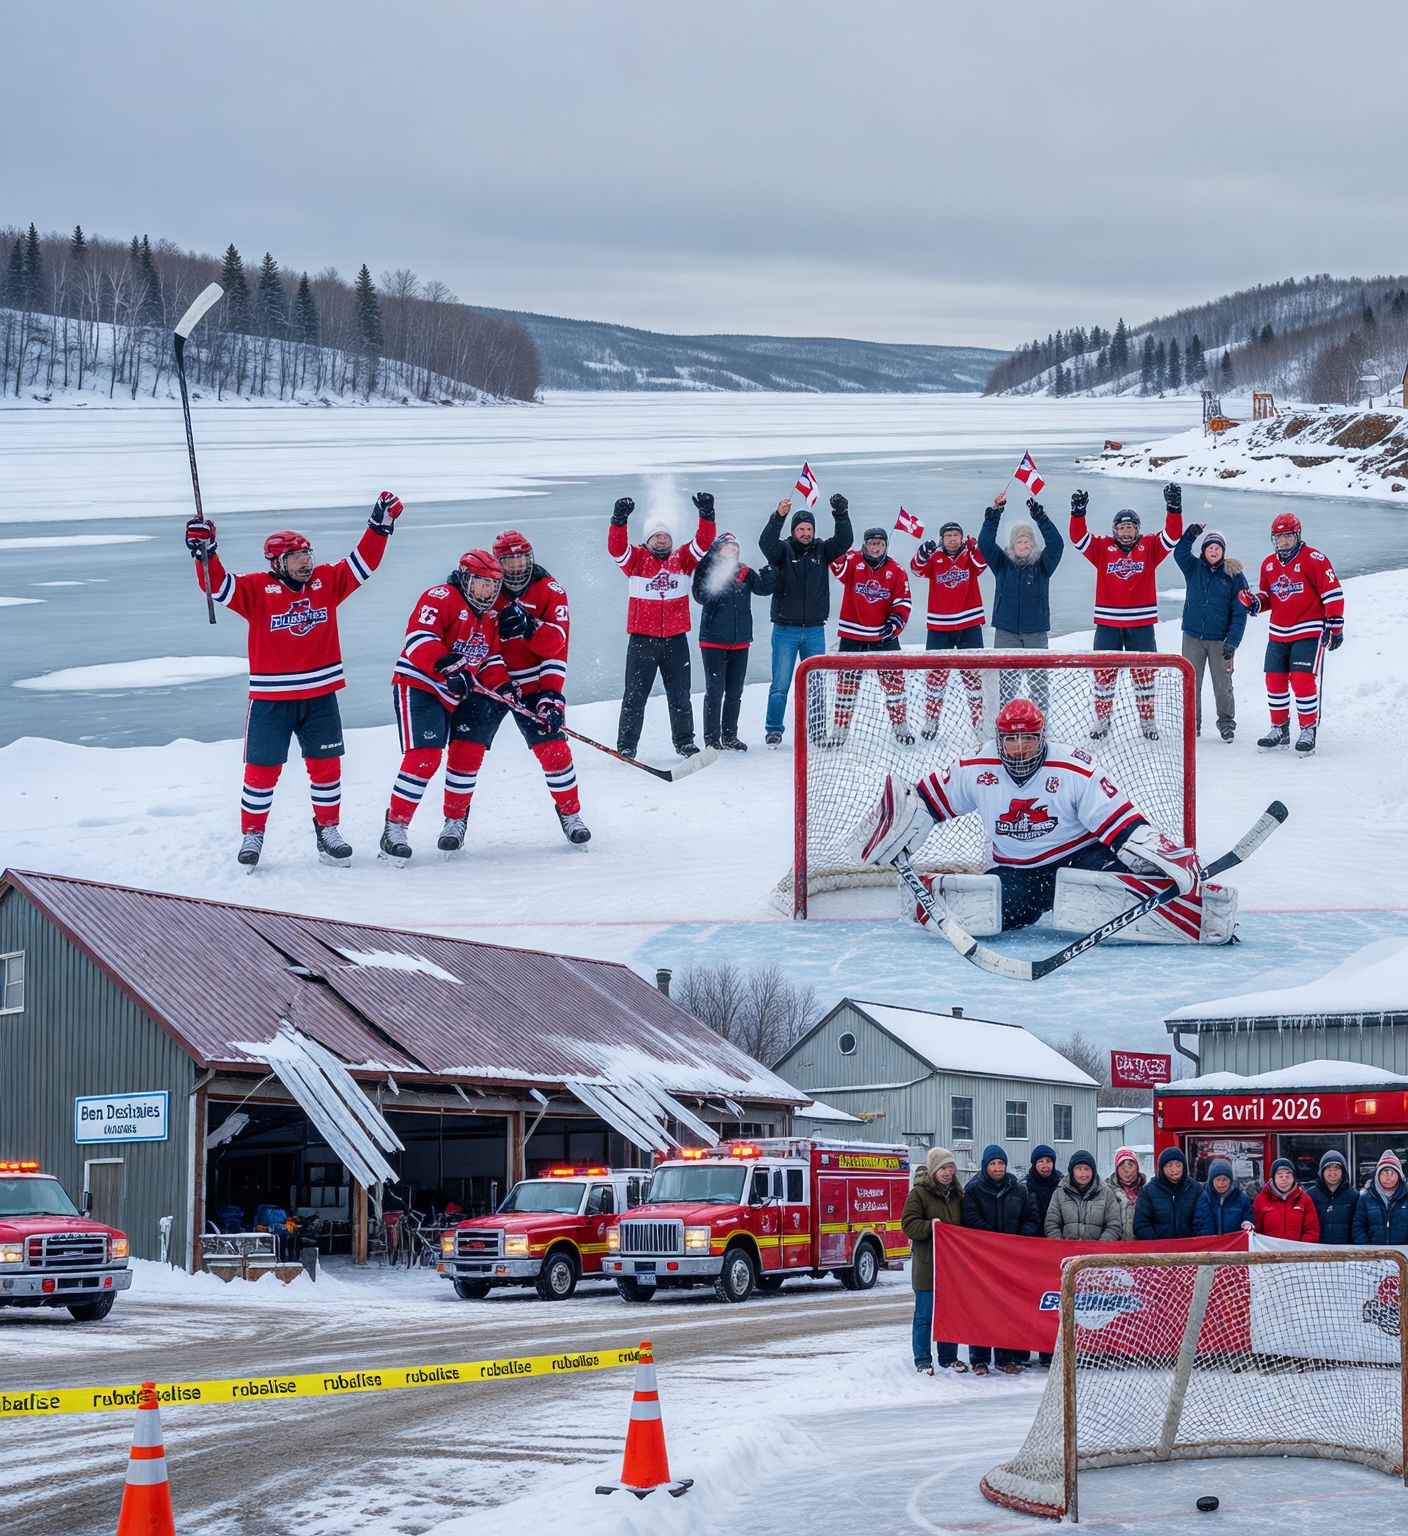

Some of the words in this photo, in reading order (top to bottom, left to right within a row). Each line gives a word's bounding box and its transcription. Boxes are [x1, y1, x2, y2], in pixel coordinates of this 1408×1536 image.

[81, 1106, 103, 1120] Ben
[1192, 1100, 1214, 1121] 12
[1222, 1098, 1264, 1120] avril
[1272, 1098, 1321, 1119] 2026
